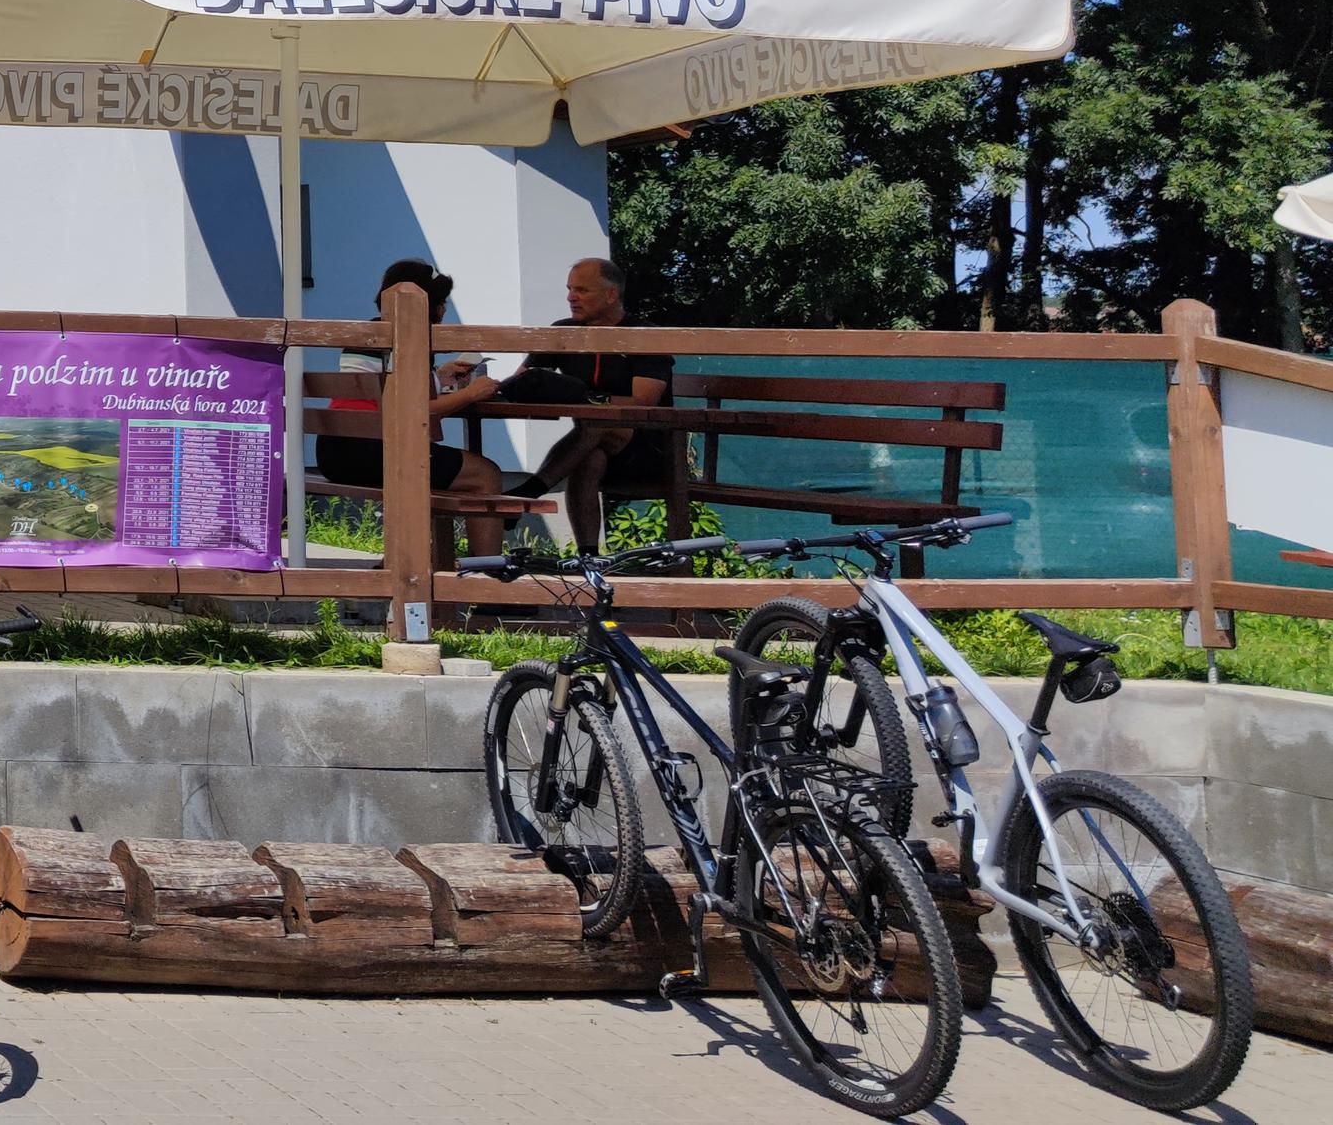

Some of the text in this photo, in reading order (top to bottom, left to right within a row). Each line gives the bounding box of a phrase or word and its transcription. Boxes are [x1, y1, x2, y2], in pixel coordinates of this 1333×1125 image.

[7, 354, 116, 397] podzim
[120, 366, 139, 386] u
[146, 362, 231, 390] vinaře
[102, 393, 268, 416] Dubňanská hora 2021
